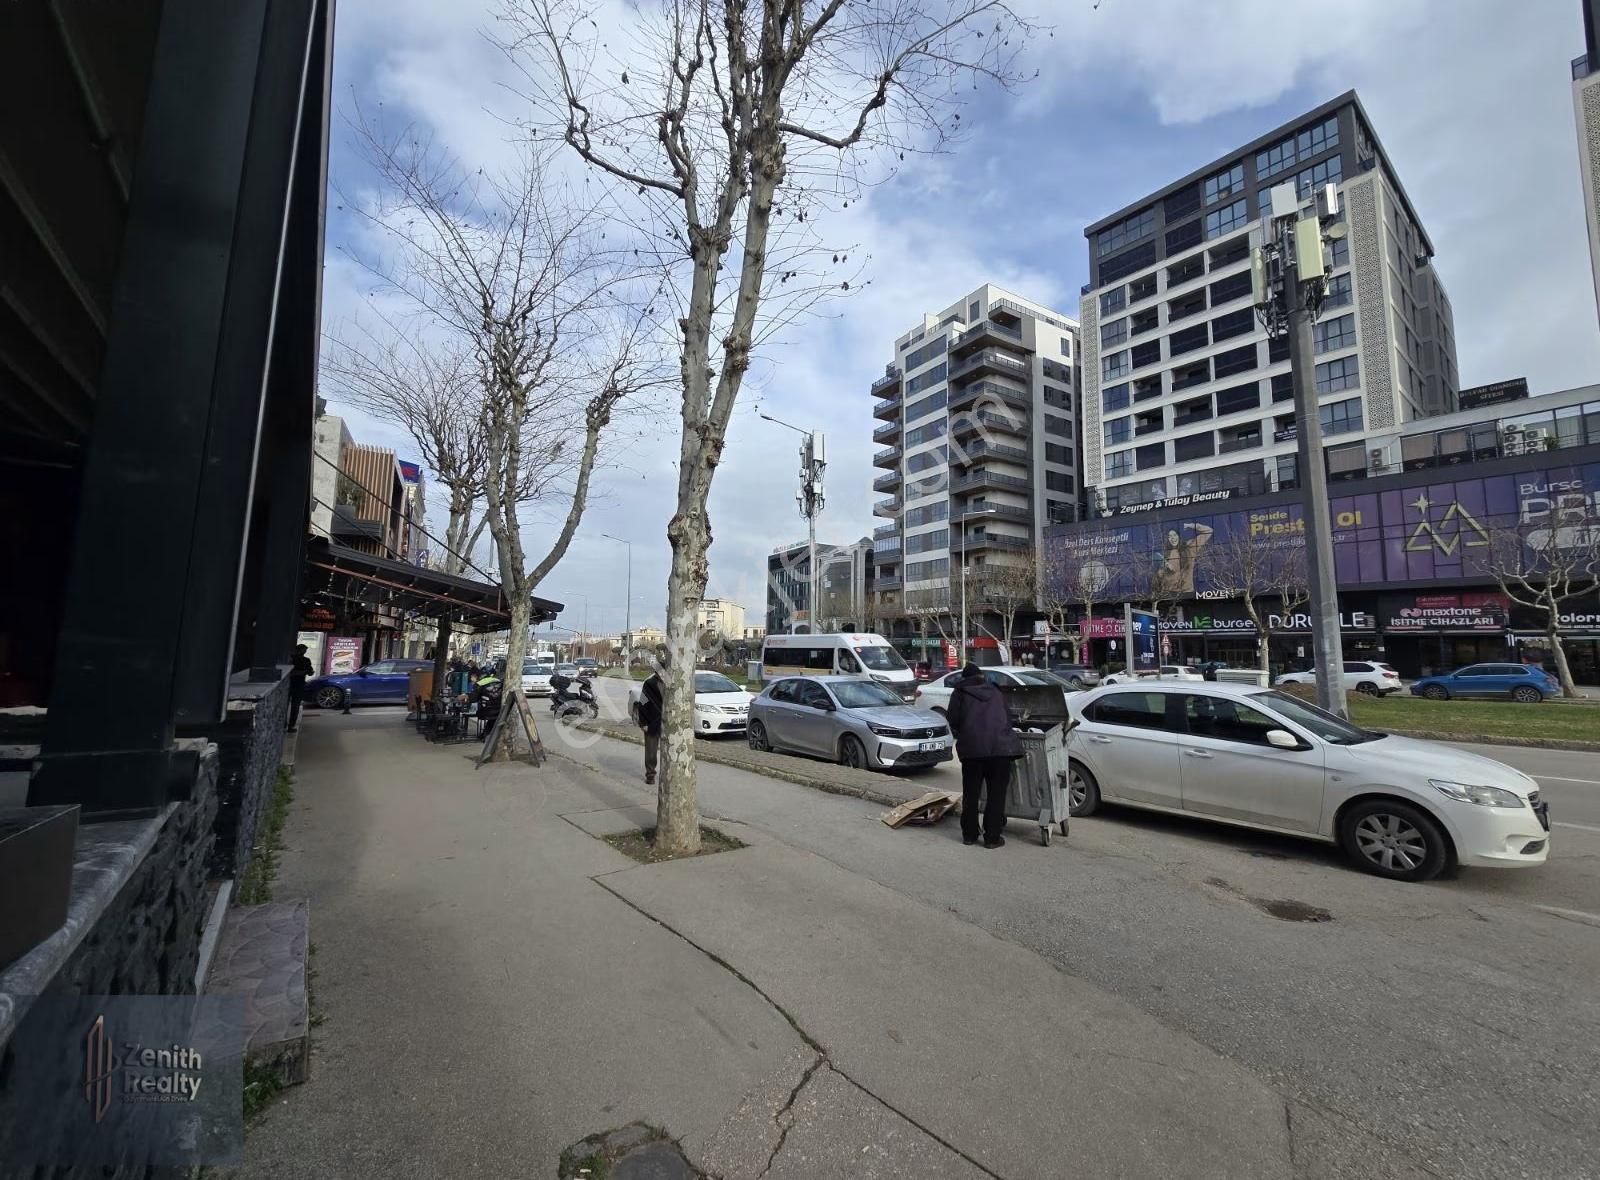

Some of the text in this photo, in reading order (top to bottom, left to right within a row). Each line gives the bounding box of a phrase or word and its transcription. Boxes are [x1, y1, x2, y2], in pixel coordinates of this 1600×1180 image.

[1120, 502, 1154, 514] Zeynep
[1155, 500, 1162, 508] &
[1193, 490, 1230, 502] Beauty
[1250, 511, 1288, 522] Sende
[1422, 607, 1482, 617] maxtone
